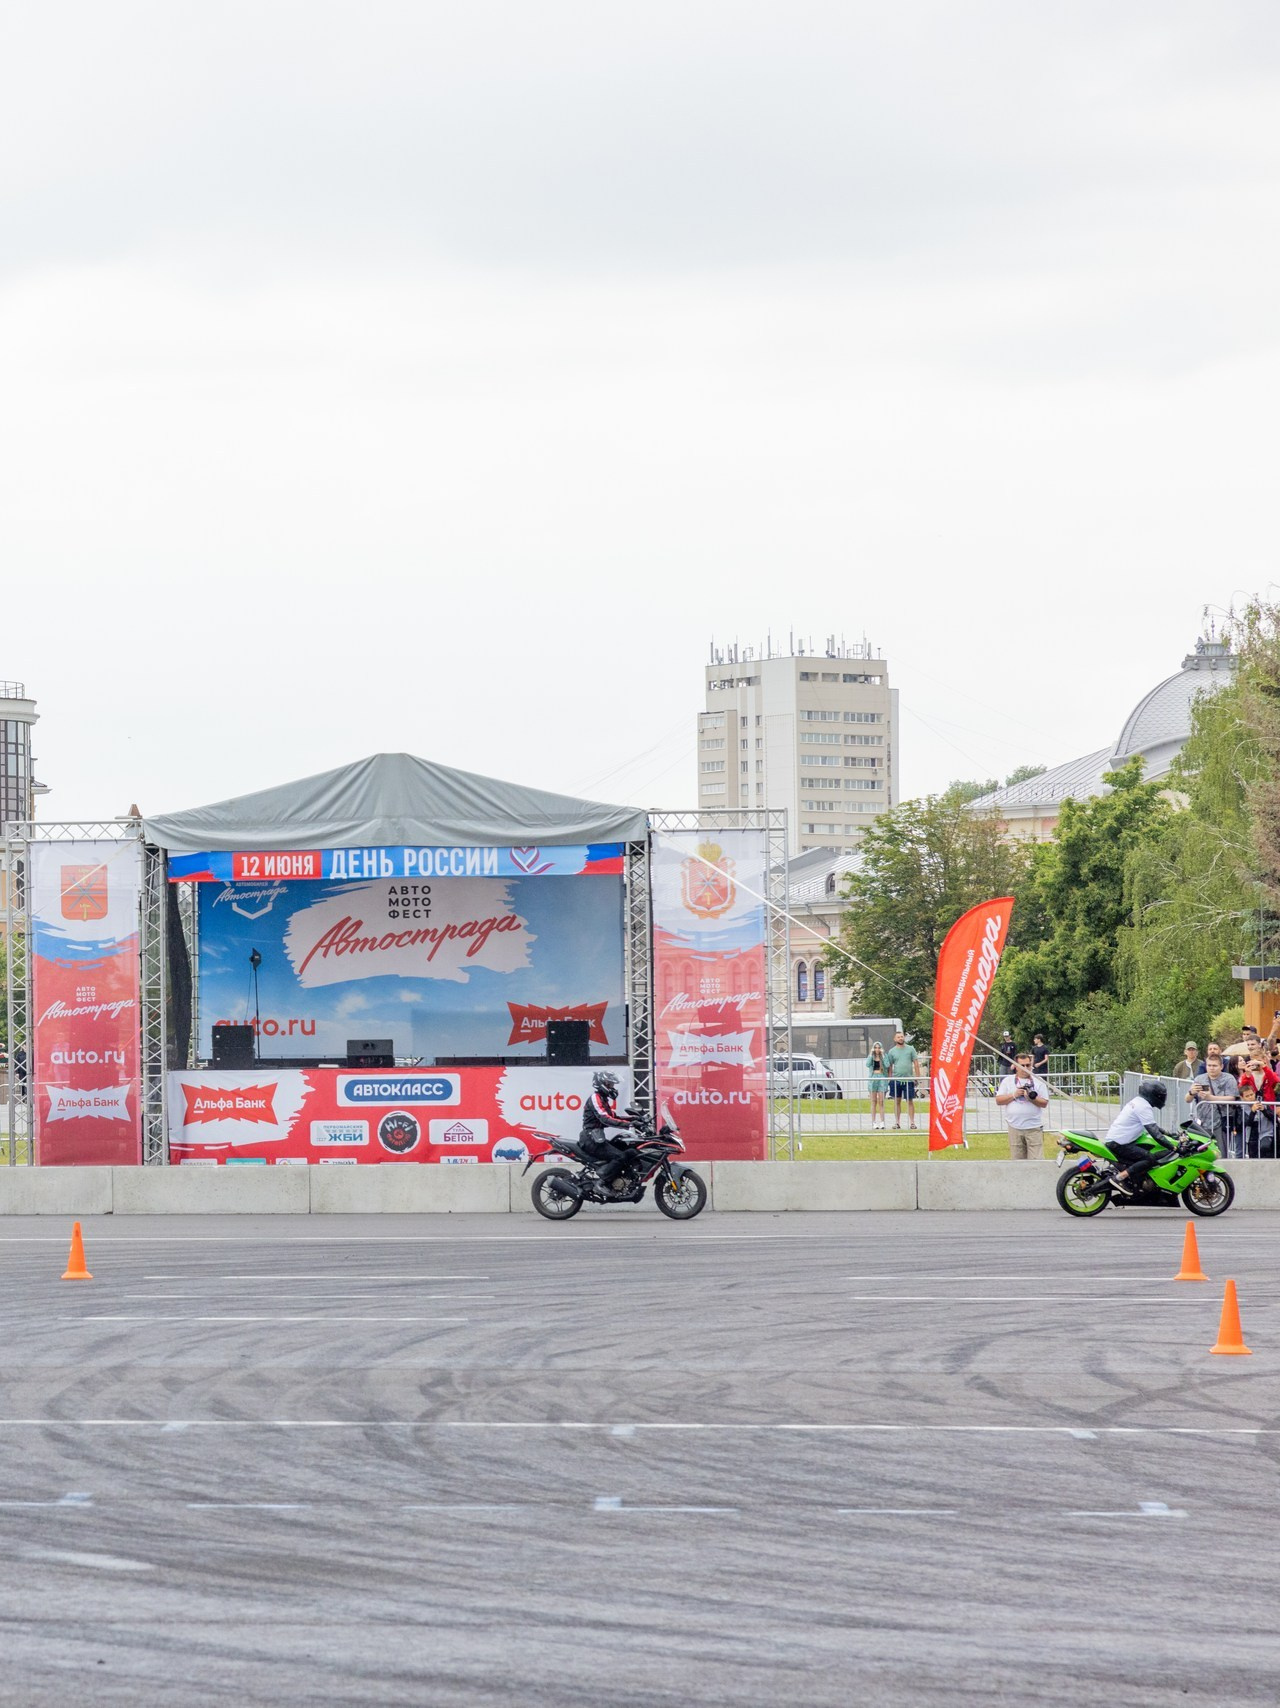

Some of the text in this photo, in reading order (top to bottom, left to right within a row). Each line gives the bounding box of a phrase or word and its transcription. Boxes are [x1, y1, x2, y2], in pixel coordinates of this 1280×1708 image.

[241, 855, 314, 877] 12 ИЮНЯ
[330, 847, 499, 880] ДЕНЬ РОССИИ
[212, 885, 289, 908] Автострада
[388, 885, 432, 896] АВТО
[388, 897, 432, 908] МОТО
[388, 908, 432, 920] ФЕСТ
[298, 914, 522, 976] Автострада
[38, 999, 136, 1027] Автострада
[659, 991, 762, 1019] Автострада
[939, 949, 975, 1061] ОТКРЫТЫЙ АВТОМОБИЛЬНЫЙ
[946, 1018, 963, 1063] ФЕСТИВАЛЬ
[50, 1049, 125, 1065] auto.ru
[679, 1043, 744, 1057] Альфа Банк
[352, 1082, 444, 1097] АВТОКЛАСС
[673, 1088, 751, 1105] auto.ru
[57, 1098, 120, 1111] Альфа Банк
[193, 1097, 266, 1114] Альфа Банк
[328, 1133, 363, 1142] ЖБИ
